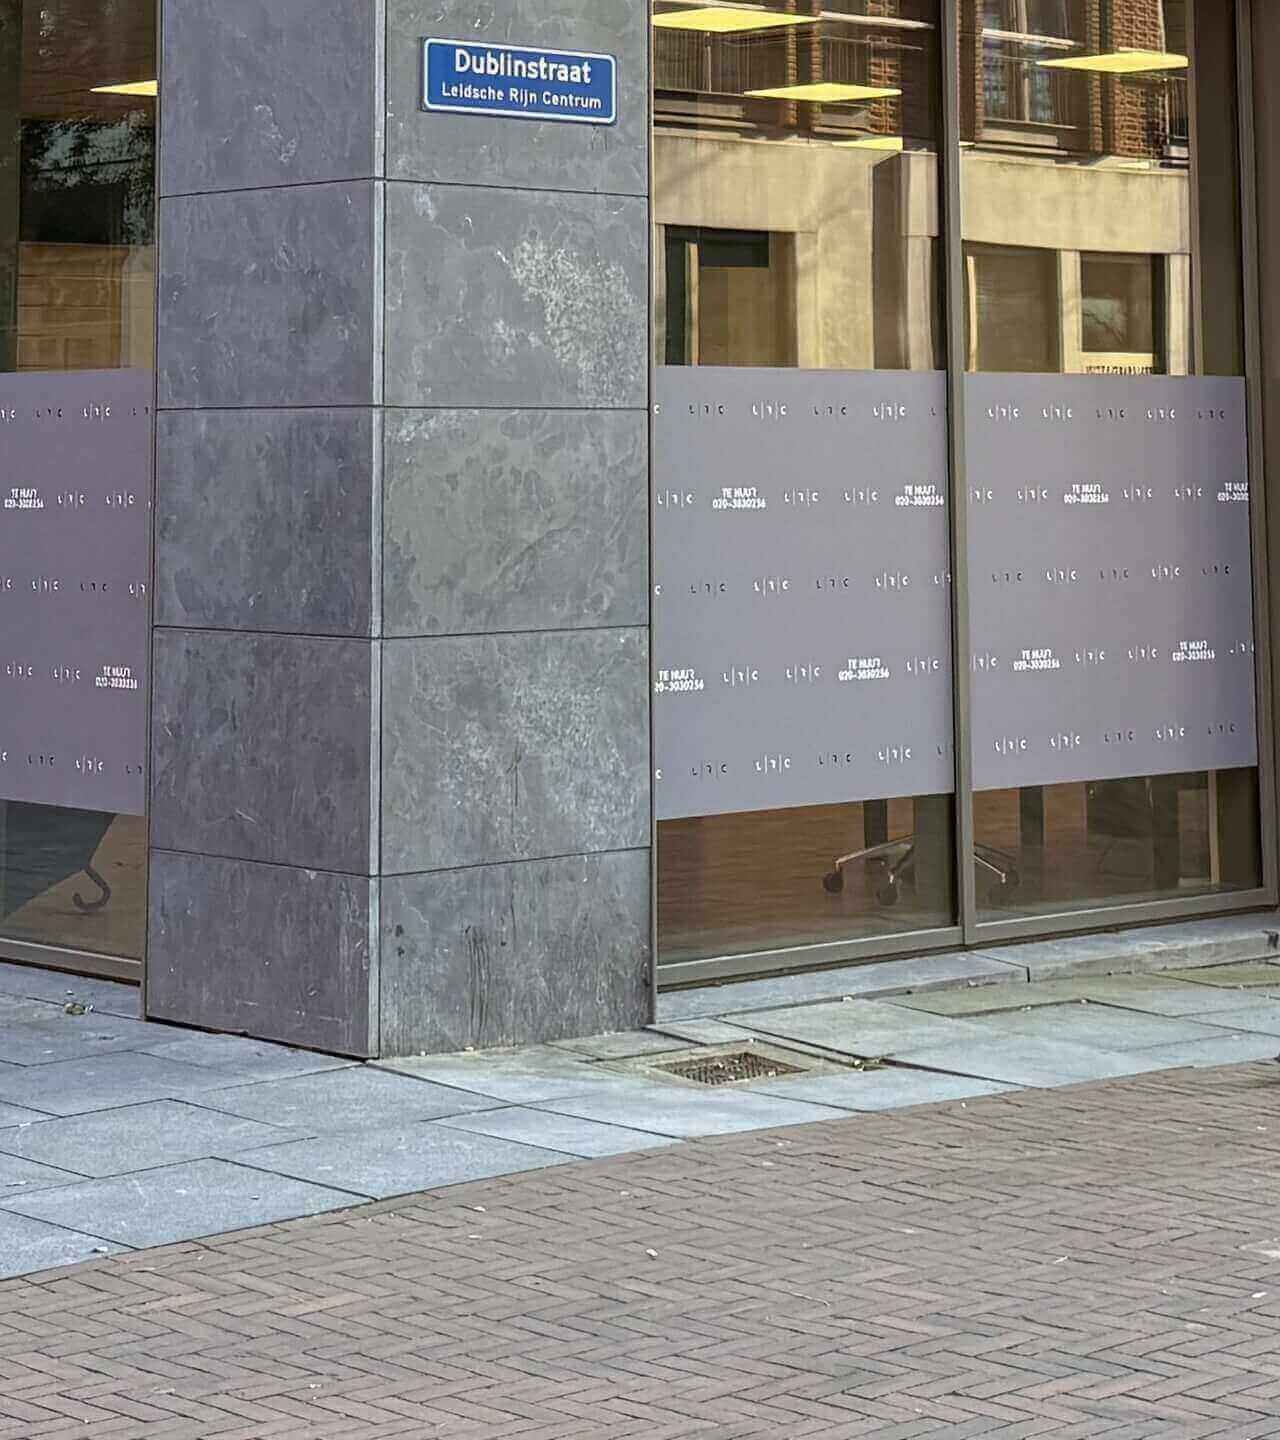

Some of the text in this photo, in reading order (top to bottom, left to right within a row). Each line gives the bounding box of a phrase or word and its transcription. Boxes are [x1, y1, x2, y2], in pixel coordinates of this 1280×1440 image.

[454, 47, 592, 85] Dublinstraat
[441, 81, 602, 110] Leidsche Rijn Centrum
